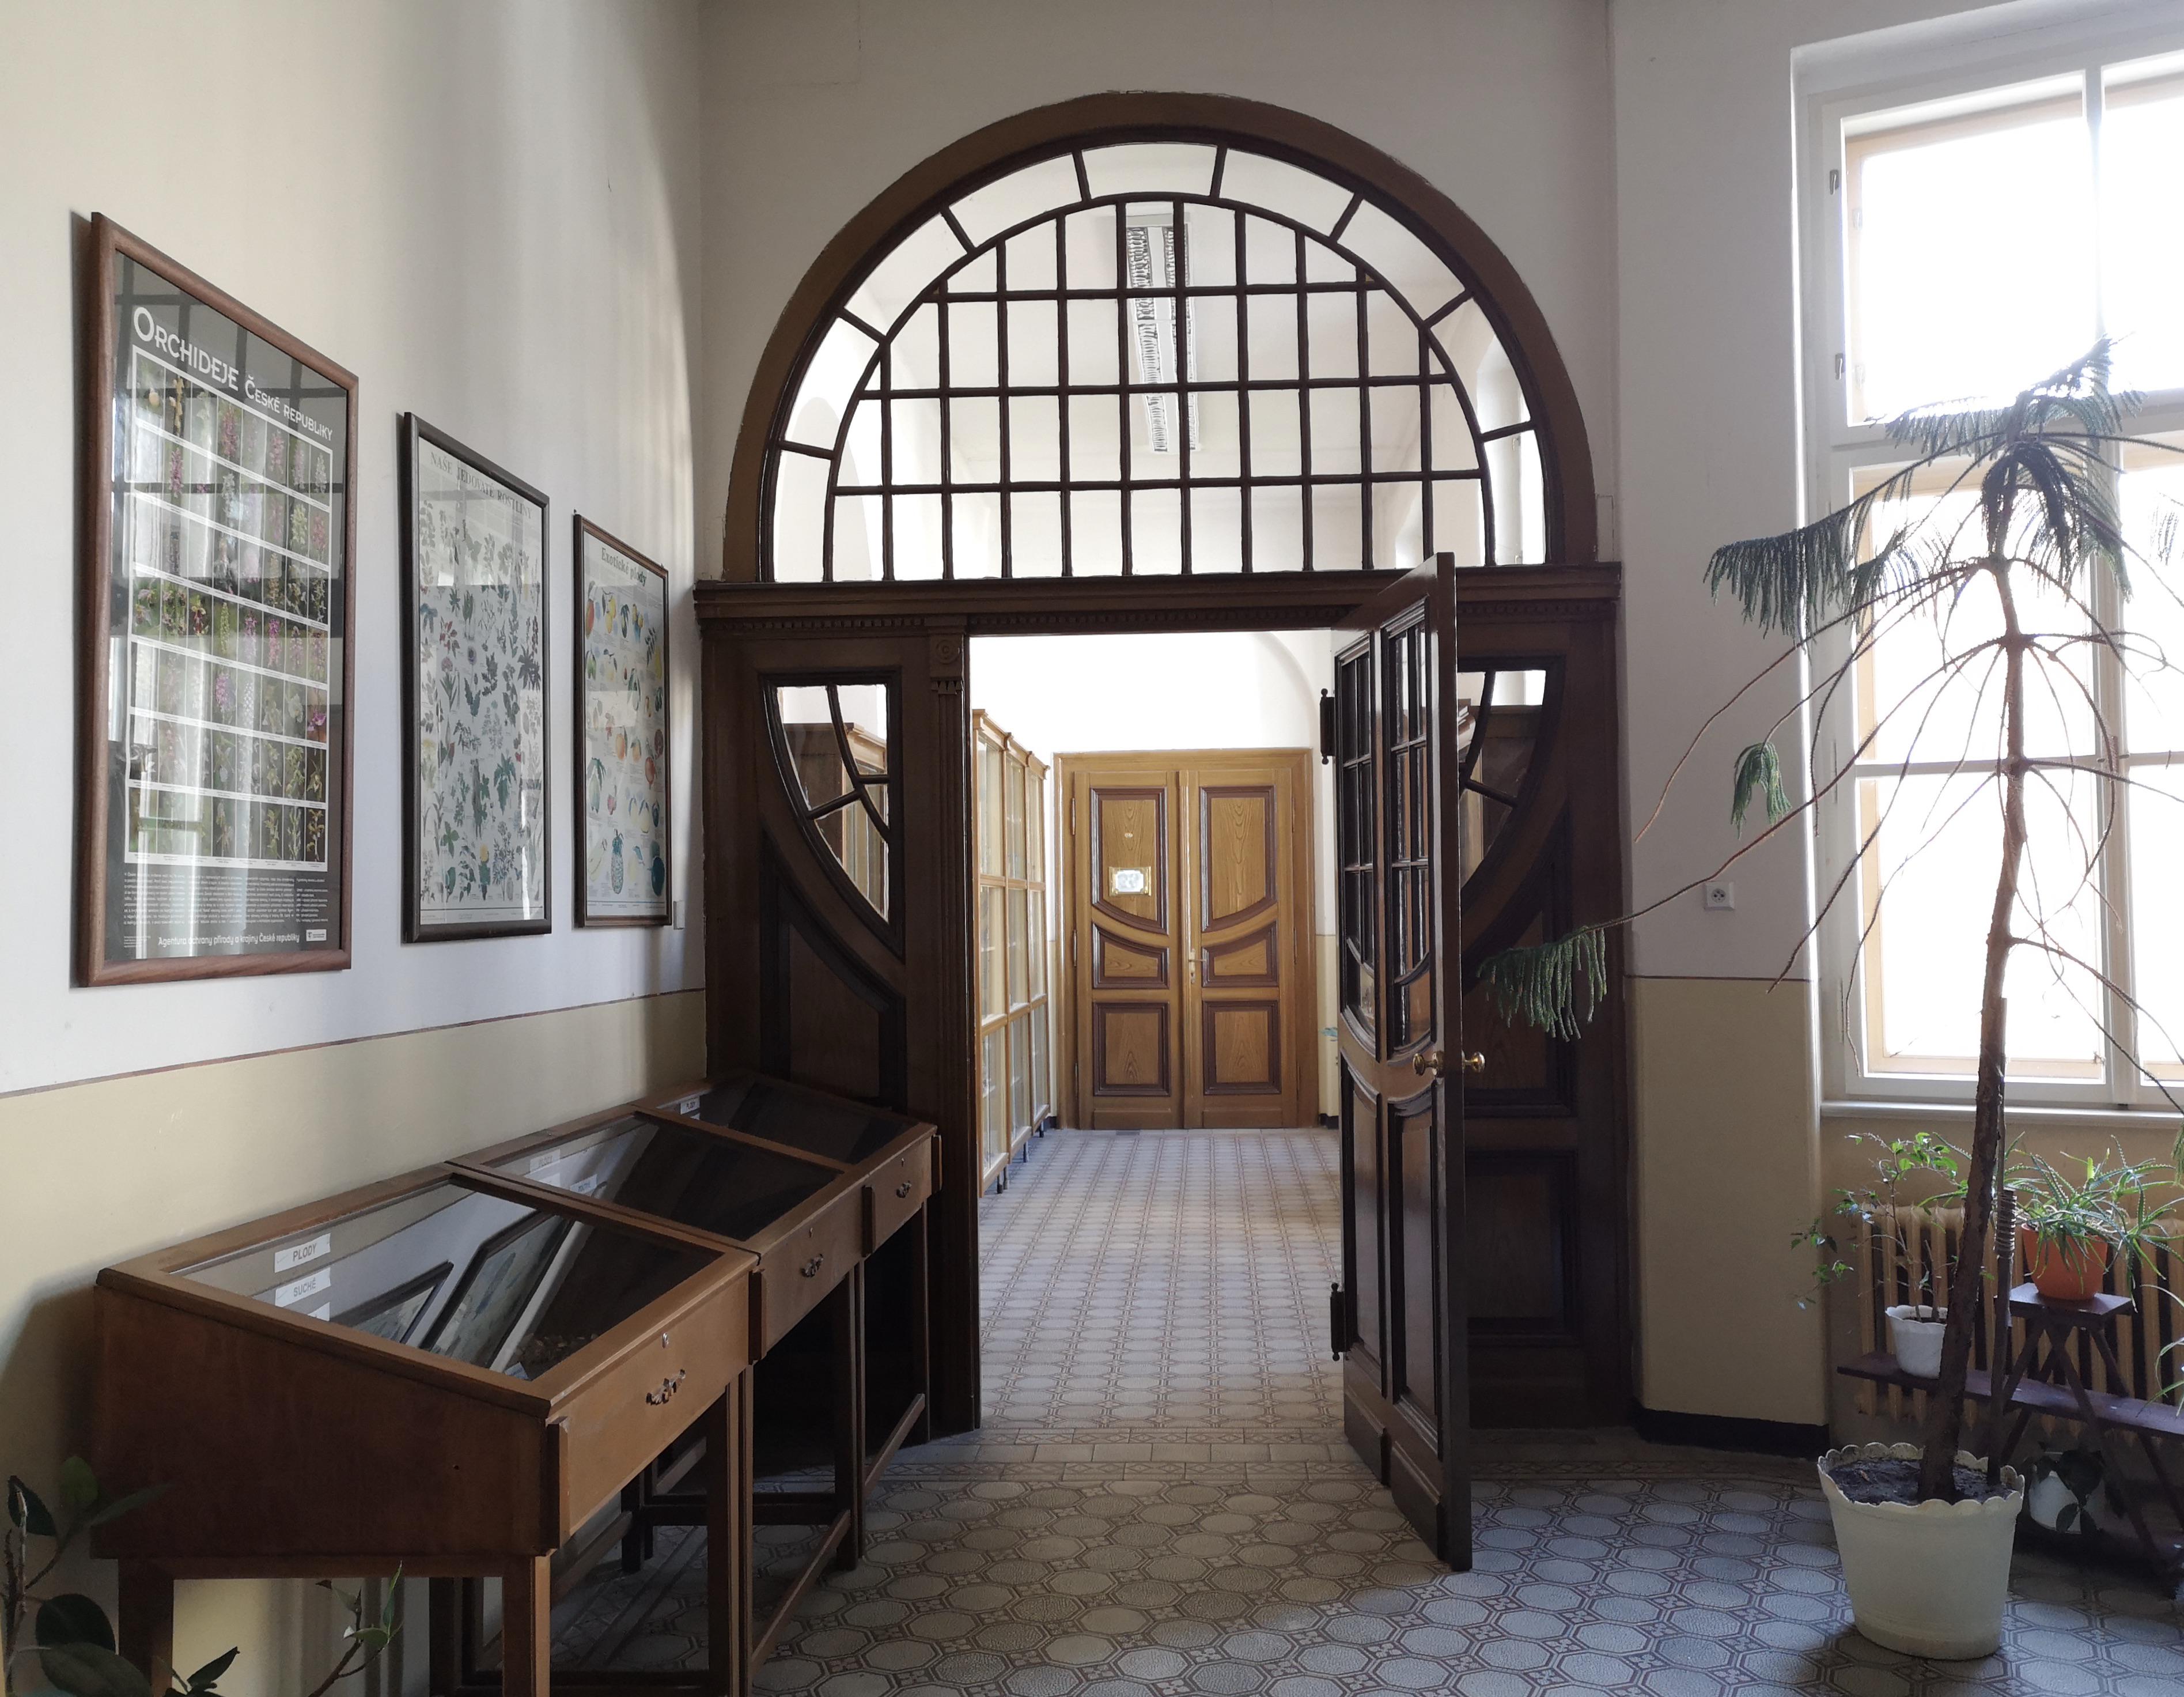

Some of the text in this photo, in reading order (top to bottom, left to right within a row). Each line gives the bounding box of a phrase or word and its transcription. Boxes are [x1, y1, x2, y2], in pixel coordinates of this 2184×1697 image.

[134, 307, 333, 442] ORCHIDEJE ČESKÉ REPUBLIKY
[430, 452, 532, 518] NAŠE JEDOVATÉ ROSTLINY
[601, 547, 647, 587] Exotické plody
[158, 937, 187, 947] Agentura
[188, 937, 212, 946] ochrany
[259, 932, 276, 943] České
[277, 932, 300, 943] republiky
[293, 1243, 317, 1262] PLODY
[293, 1277, 317, 1297] SUCHÉ
